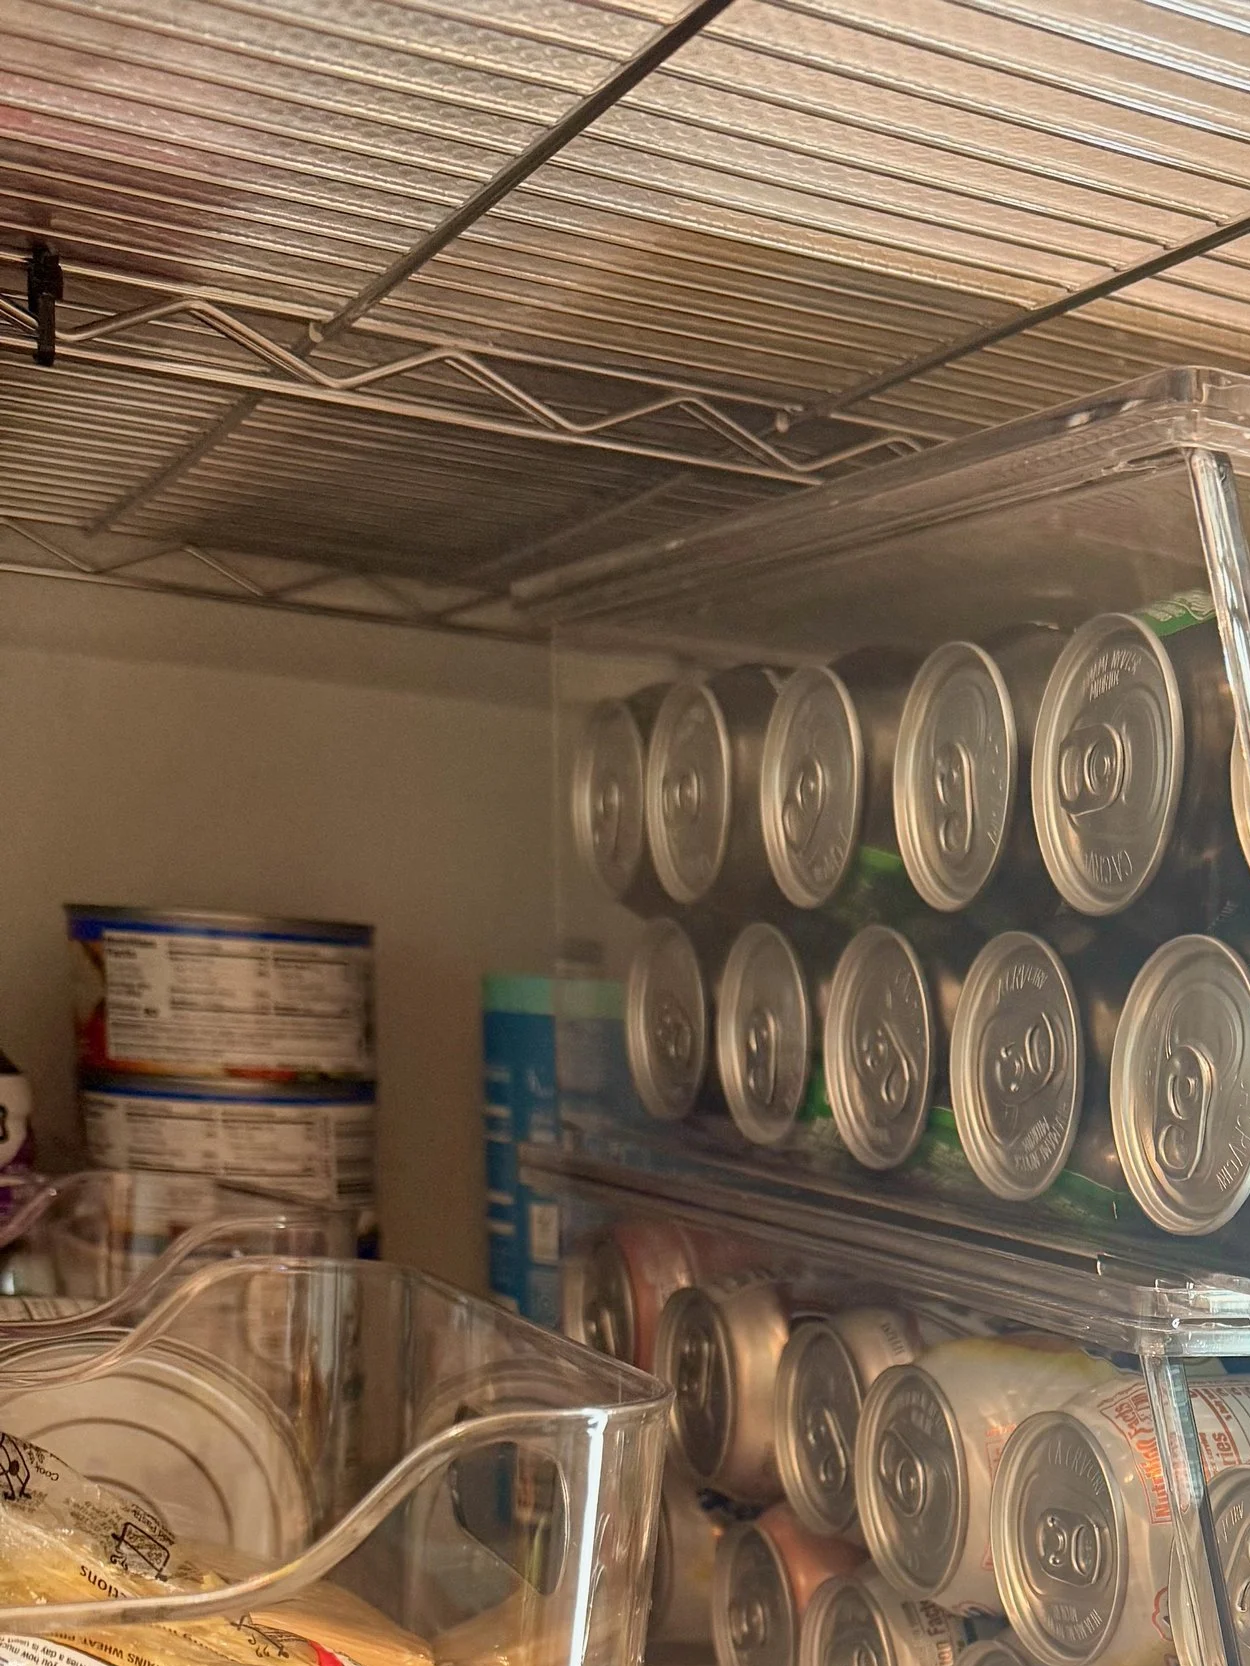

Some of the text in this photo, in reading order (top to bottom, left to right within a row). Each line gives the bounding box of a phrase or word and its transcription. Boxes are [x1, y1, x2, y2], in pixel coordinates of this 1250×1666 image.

[20, 1647, 41, 1664] how
[39, 1642, 59, 1660] day
[57, 1653, 65, 1662] a
